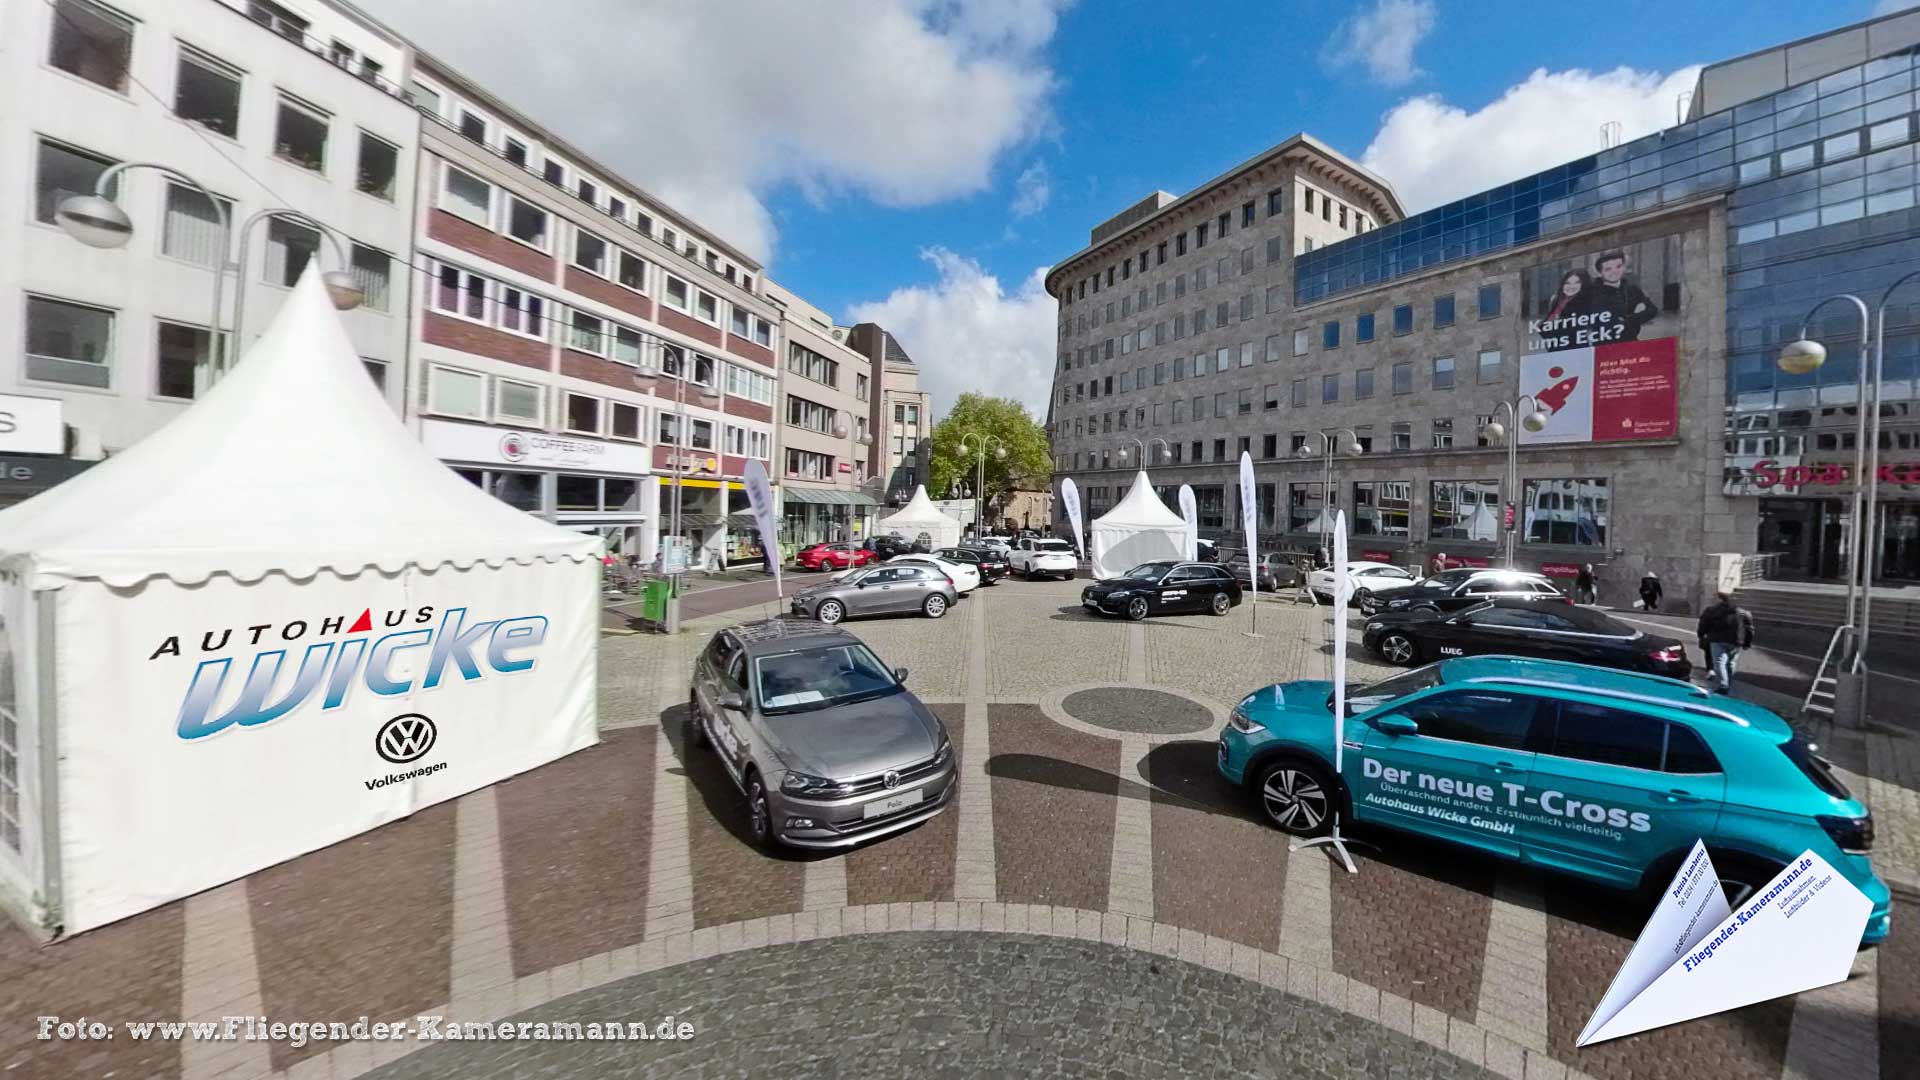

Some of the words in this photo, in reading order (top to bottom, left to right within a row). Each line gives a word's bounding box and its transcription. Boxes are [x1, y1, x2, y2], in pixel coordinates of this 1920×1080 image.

[1528, 310, 1612, 334] Karriere
[1528, 335, 1570, 350] ums
[1576, 324, 1625, 345] Eck?
[1440, 646, 1463, 656] LUEG
[364, 760, 448, 791] Volkswagen
[1363, 757, 1412, 781] Der
[1417, 773, 1495, 802] neue
[1502, 782, 1652, 833] T-Cross
[1365, 792, 1425, 816] Autohaus
[1427, 805, 1468, 826] Wicke
[1470, 816, 1516, 836] GmbH
[1380, 782, 1451, 805] Überraschend
[1453, 798, 1494, 815] anders.
[1565, 820, 1626, 842] vielseitig.
